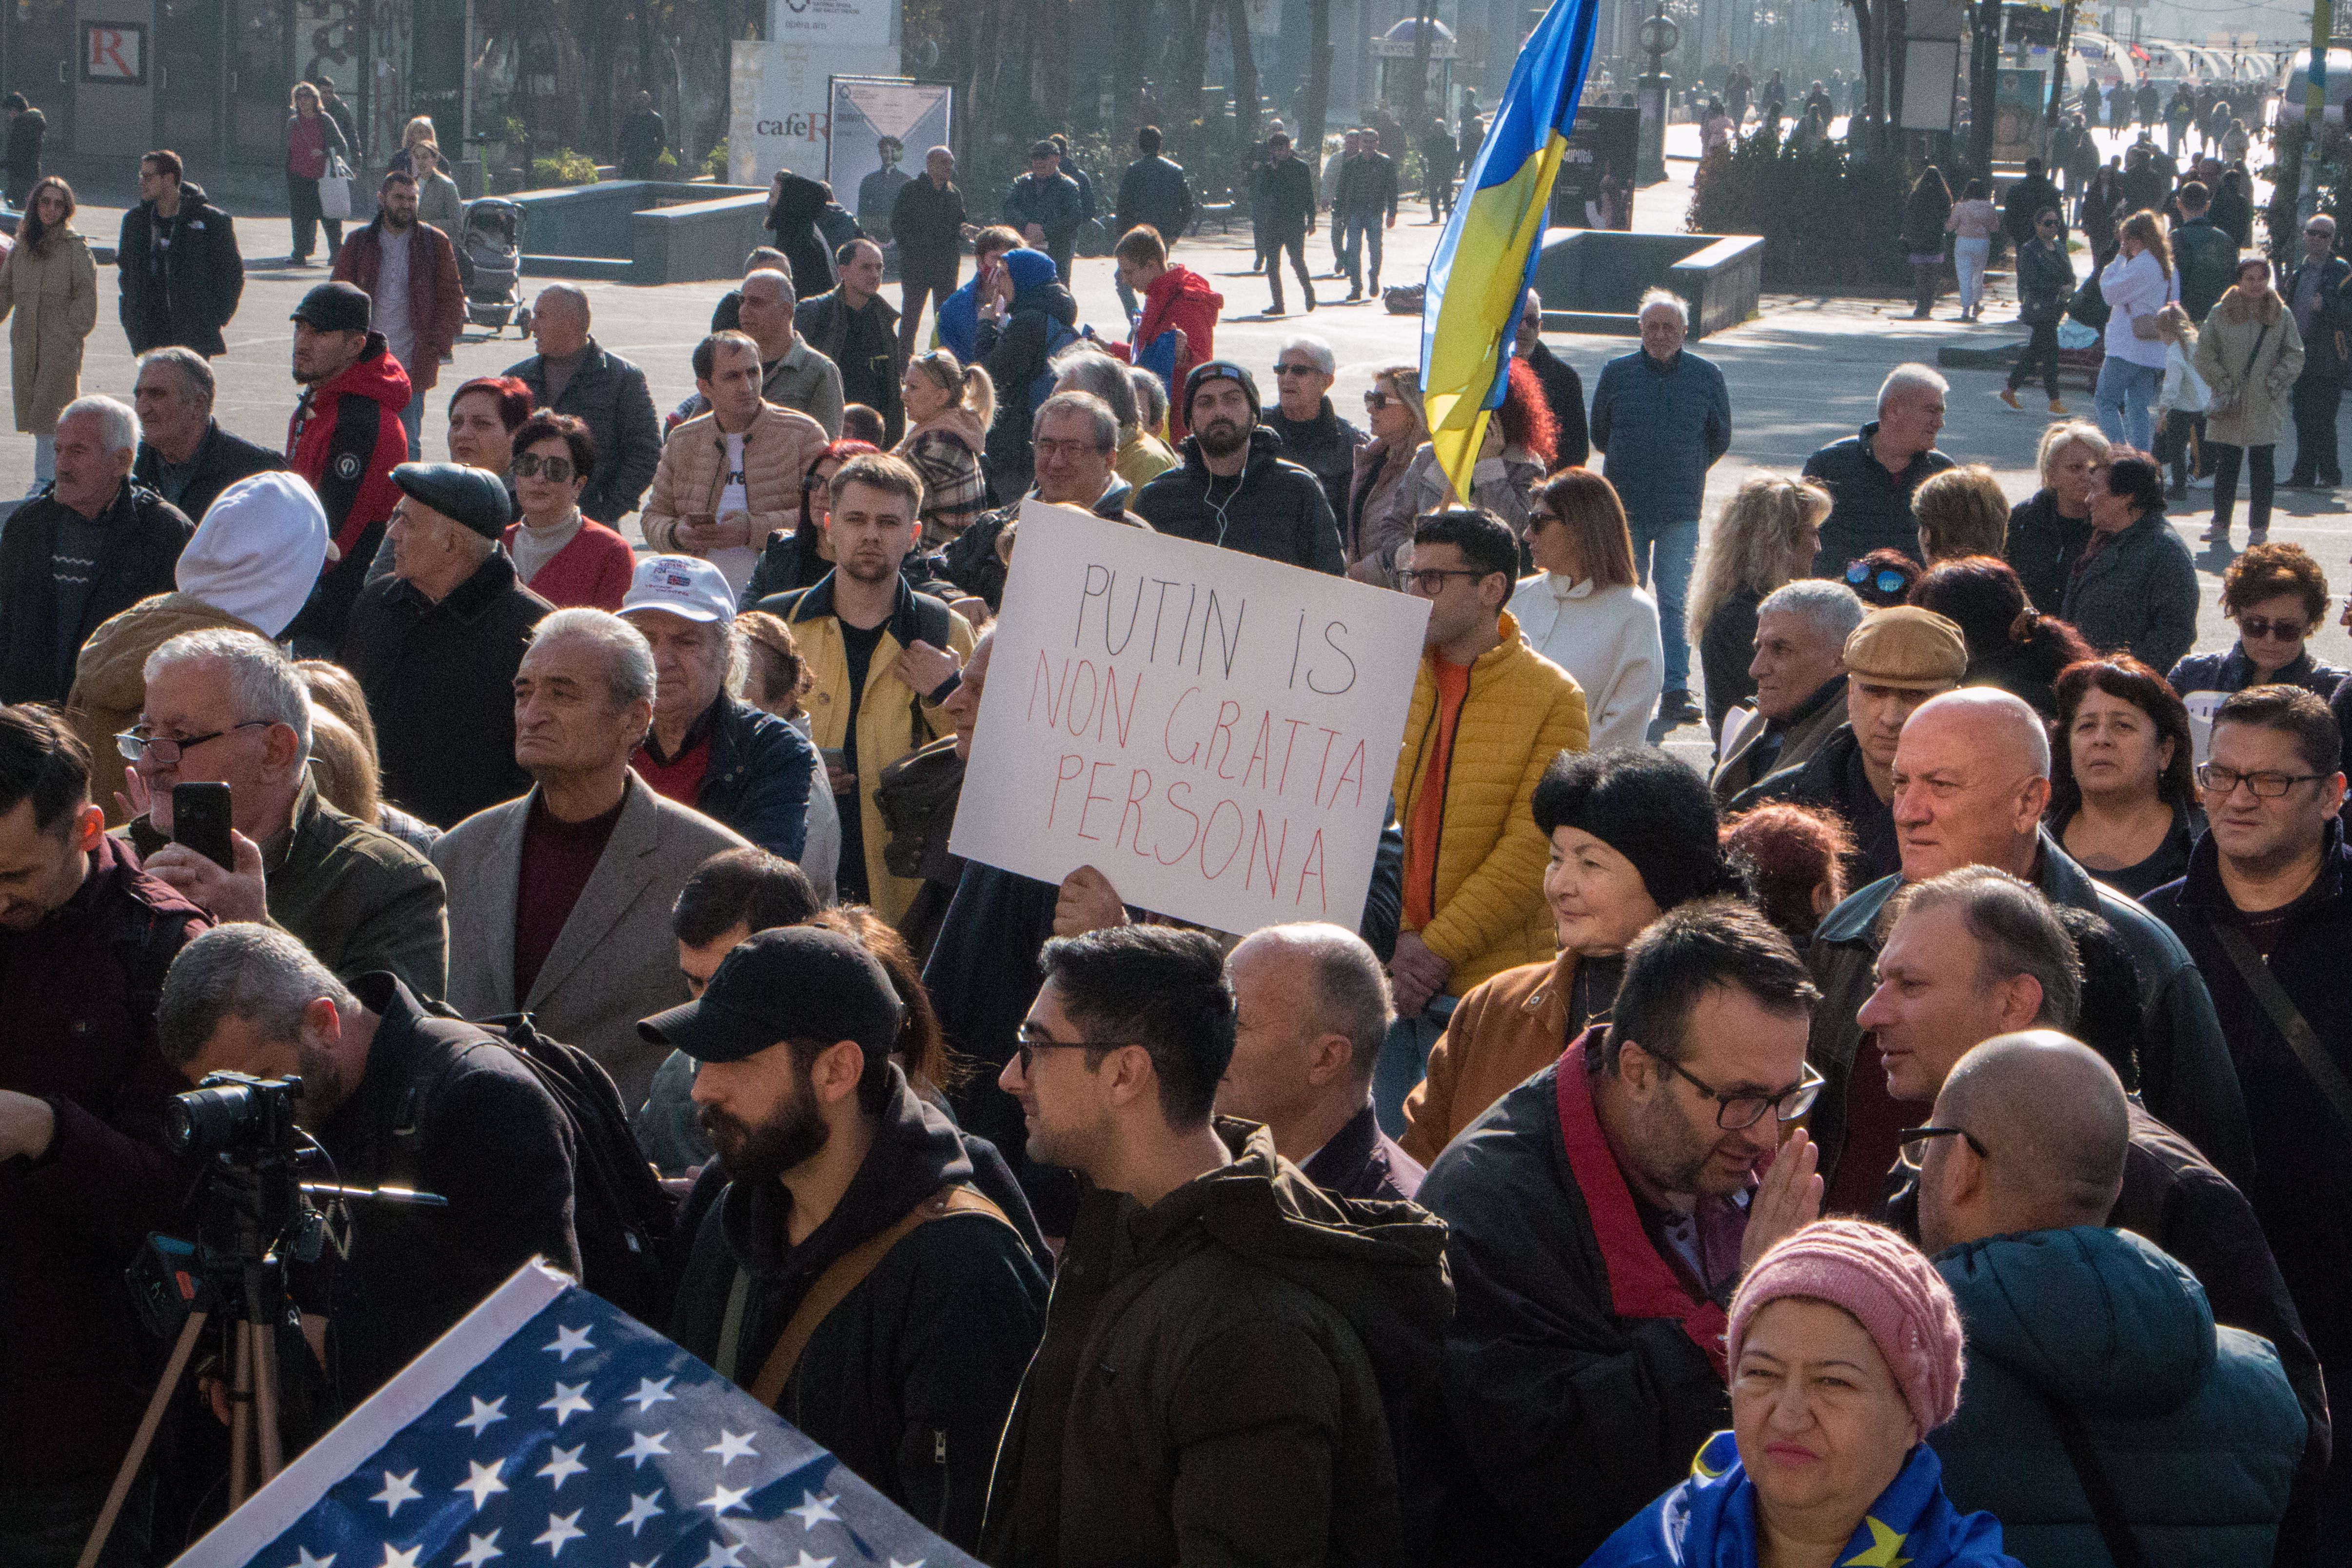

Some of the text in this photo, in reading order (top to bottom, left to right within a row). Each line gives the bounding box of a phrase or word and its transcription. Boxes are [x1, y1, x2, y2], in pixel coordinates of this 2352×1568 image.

[89, 28, 132, 77] R
[1074, 563, 1245, 681] PUTIN
[1027, 649, 1365, 810] NON GRATTA
[1048, 754, 1326, 913] PERSONA
